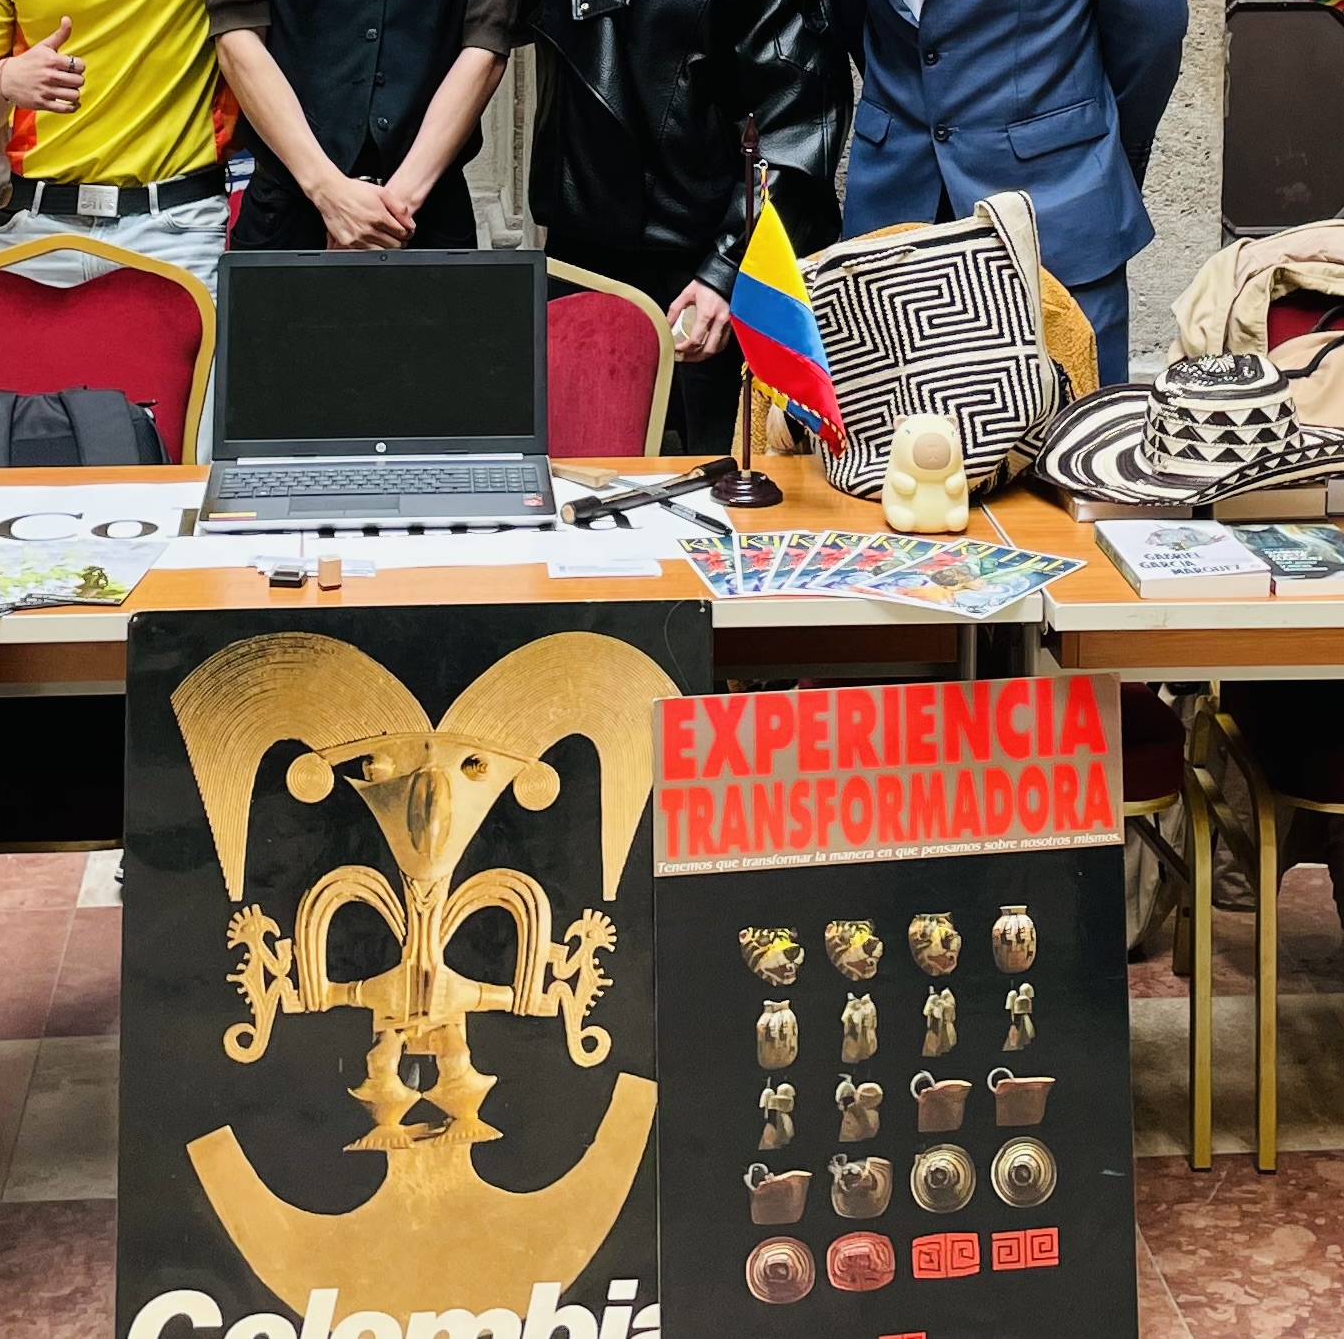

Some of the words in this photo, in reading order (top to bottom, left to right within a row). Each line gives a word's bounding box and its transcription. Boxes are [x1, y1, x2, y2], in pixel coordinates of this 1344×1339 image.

[662, 675, 1108, 782] EXPERIENCIA
[657, 862, 713, 874] Tenemos
[716, 859, 739, 872] que
[742, 854, 811, 868] transformar
[815, 851, 826, 862] la
[829, 849, 874, 862] manera
[877, 848, 892, 858] en
[895, 846, 918, 860] que
[921, 842, 981, 858] pensamos
[983, 839, 1017, 851] sobre
[1021, 835, 1070, 849] nosotros
[1073, 832, 1121, 845] mismos.
[660, 762, 1113, 858] TRANSFORMADORA
